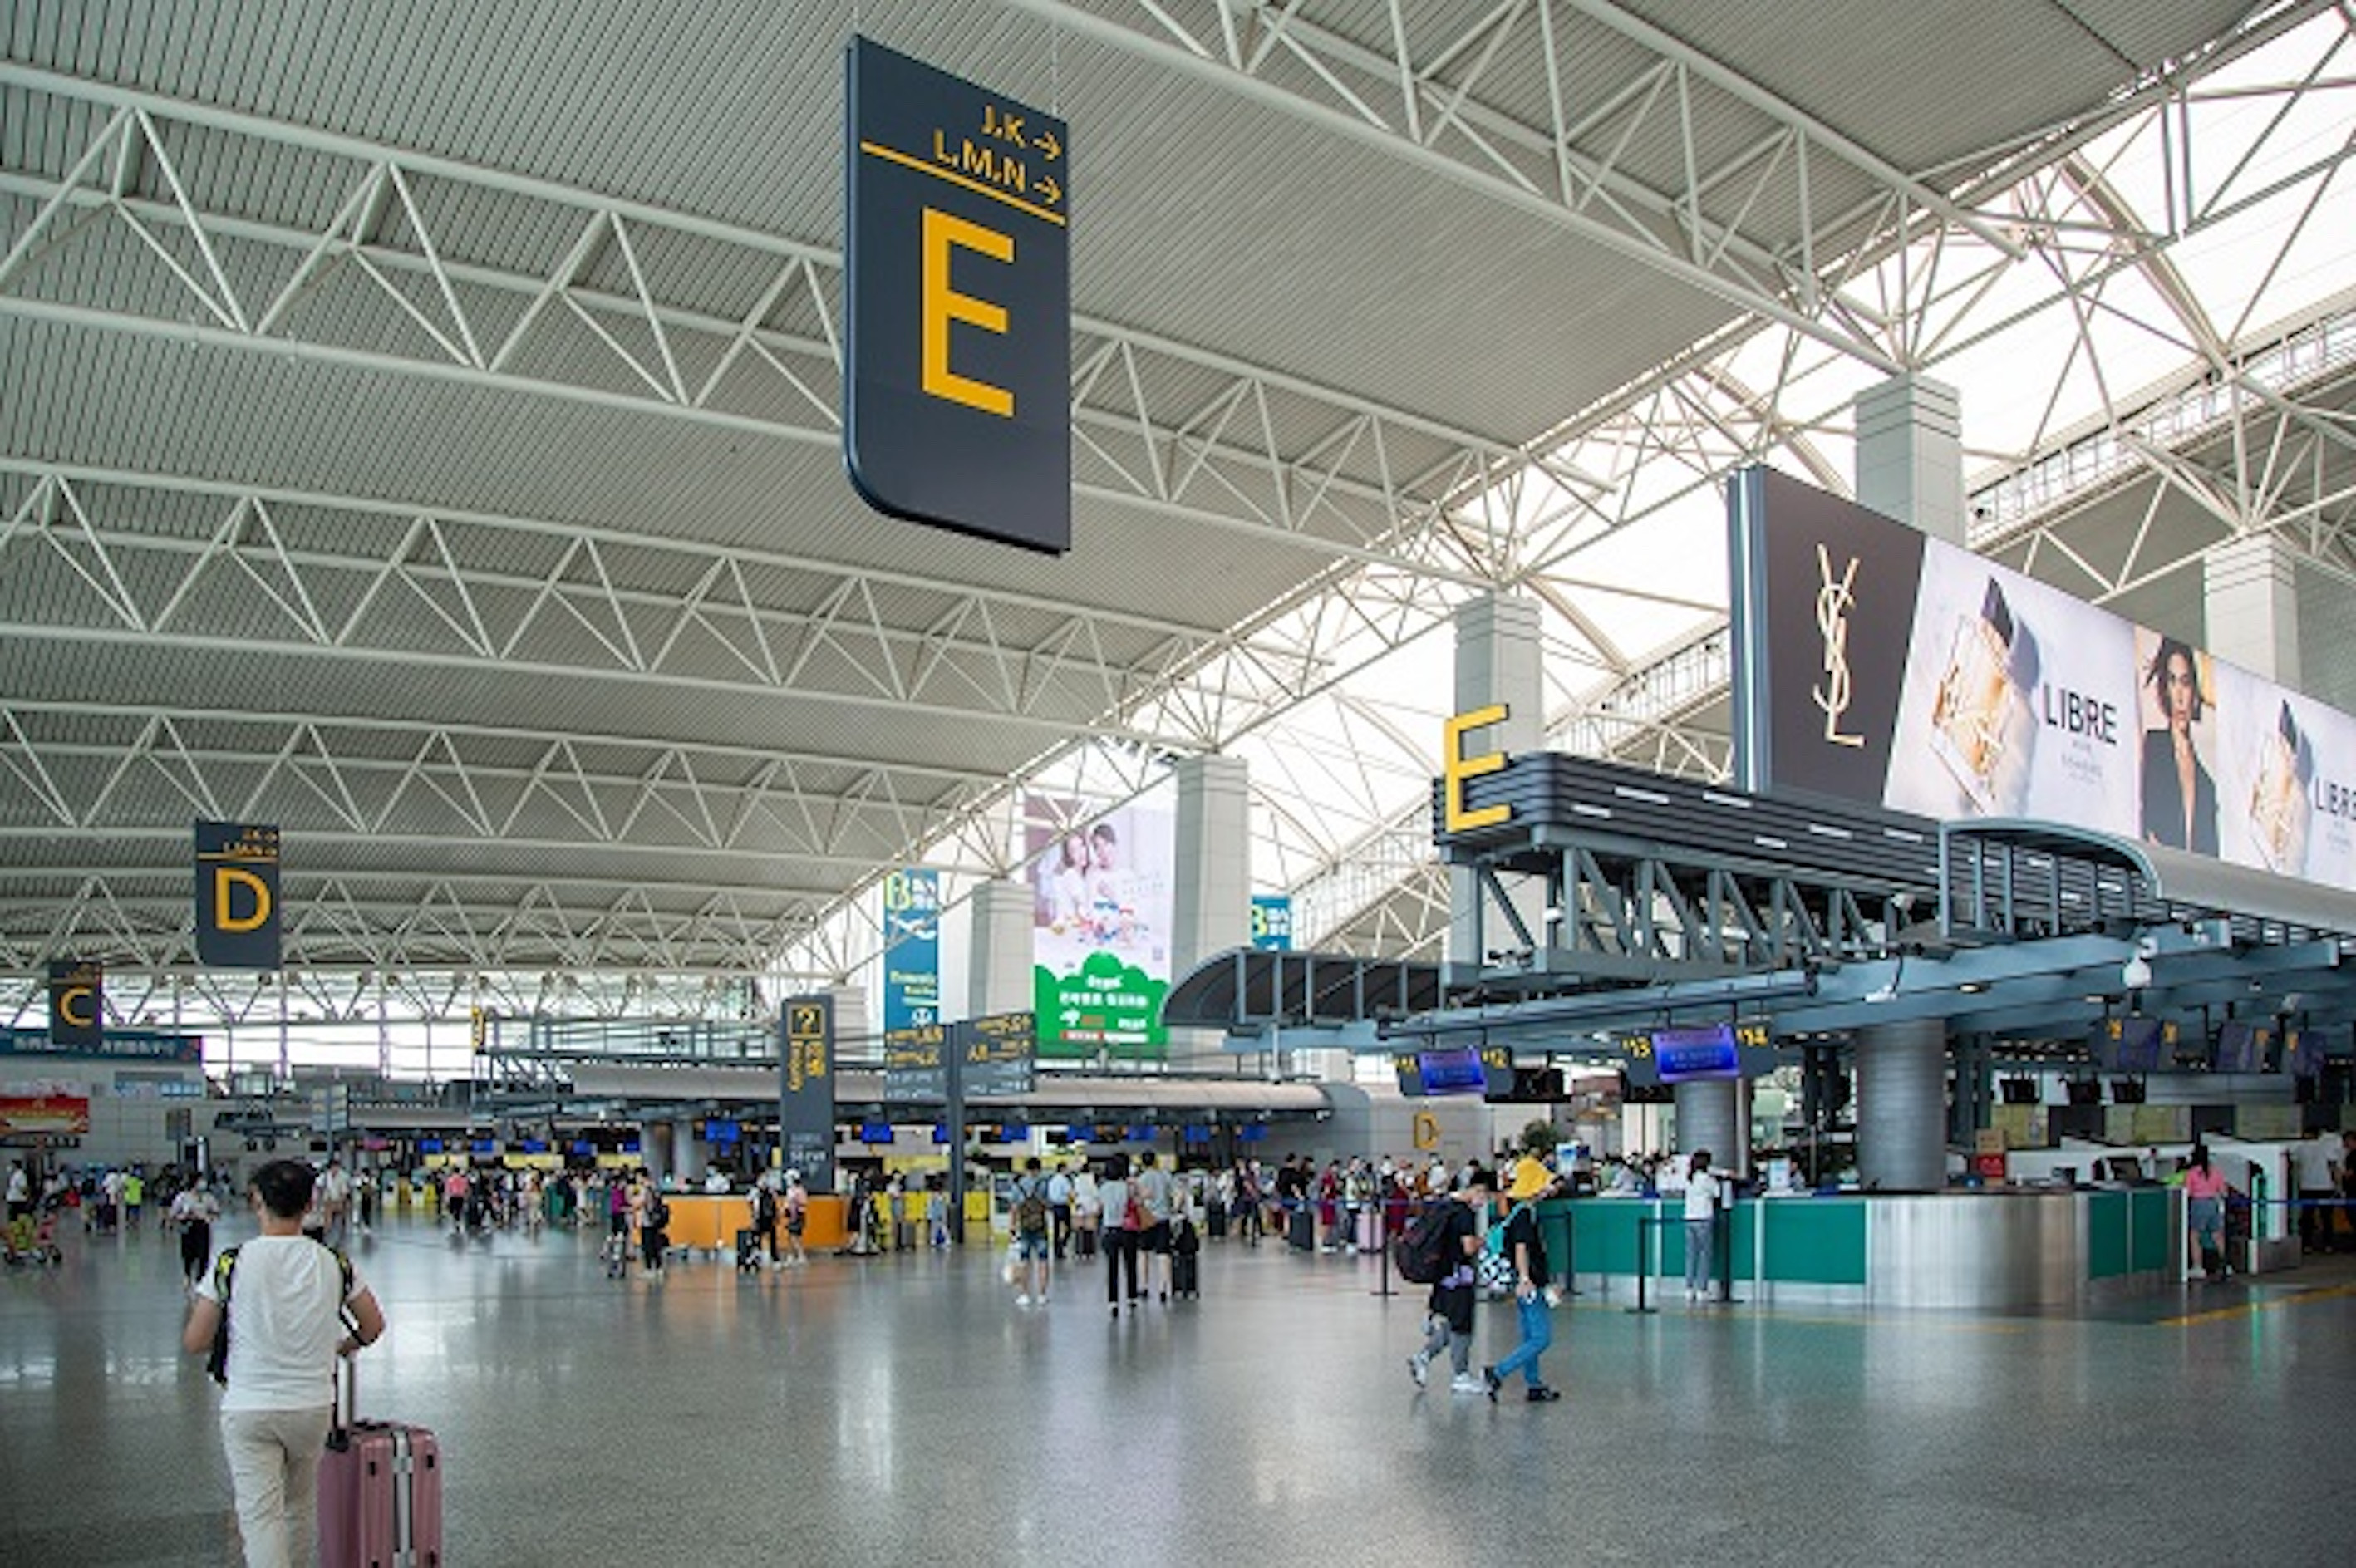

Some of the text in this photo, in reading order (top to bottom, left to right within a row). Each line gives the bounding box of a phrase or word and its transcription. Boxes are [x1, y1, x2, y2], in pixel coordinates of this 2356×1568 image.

[922, 206, 1015, 418] E
[2044, 682, 2117, 746] LIBRE
[1444, 704, 1512, 833] E
[215, 867, 272, 931] D
[59, 986, 93, 1027] C
